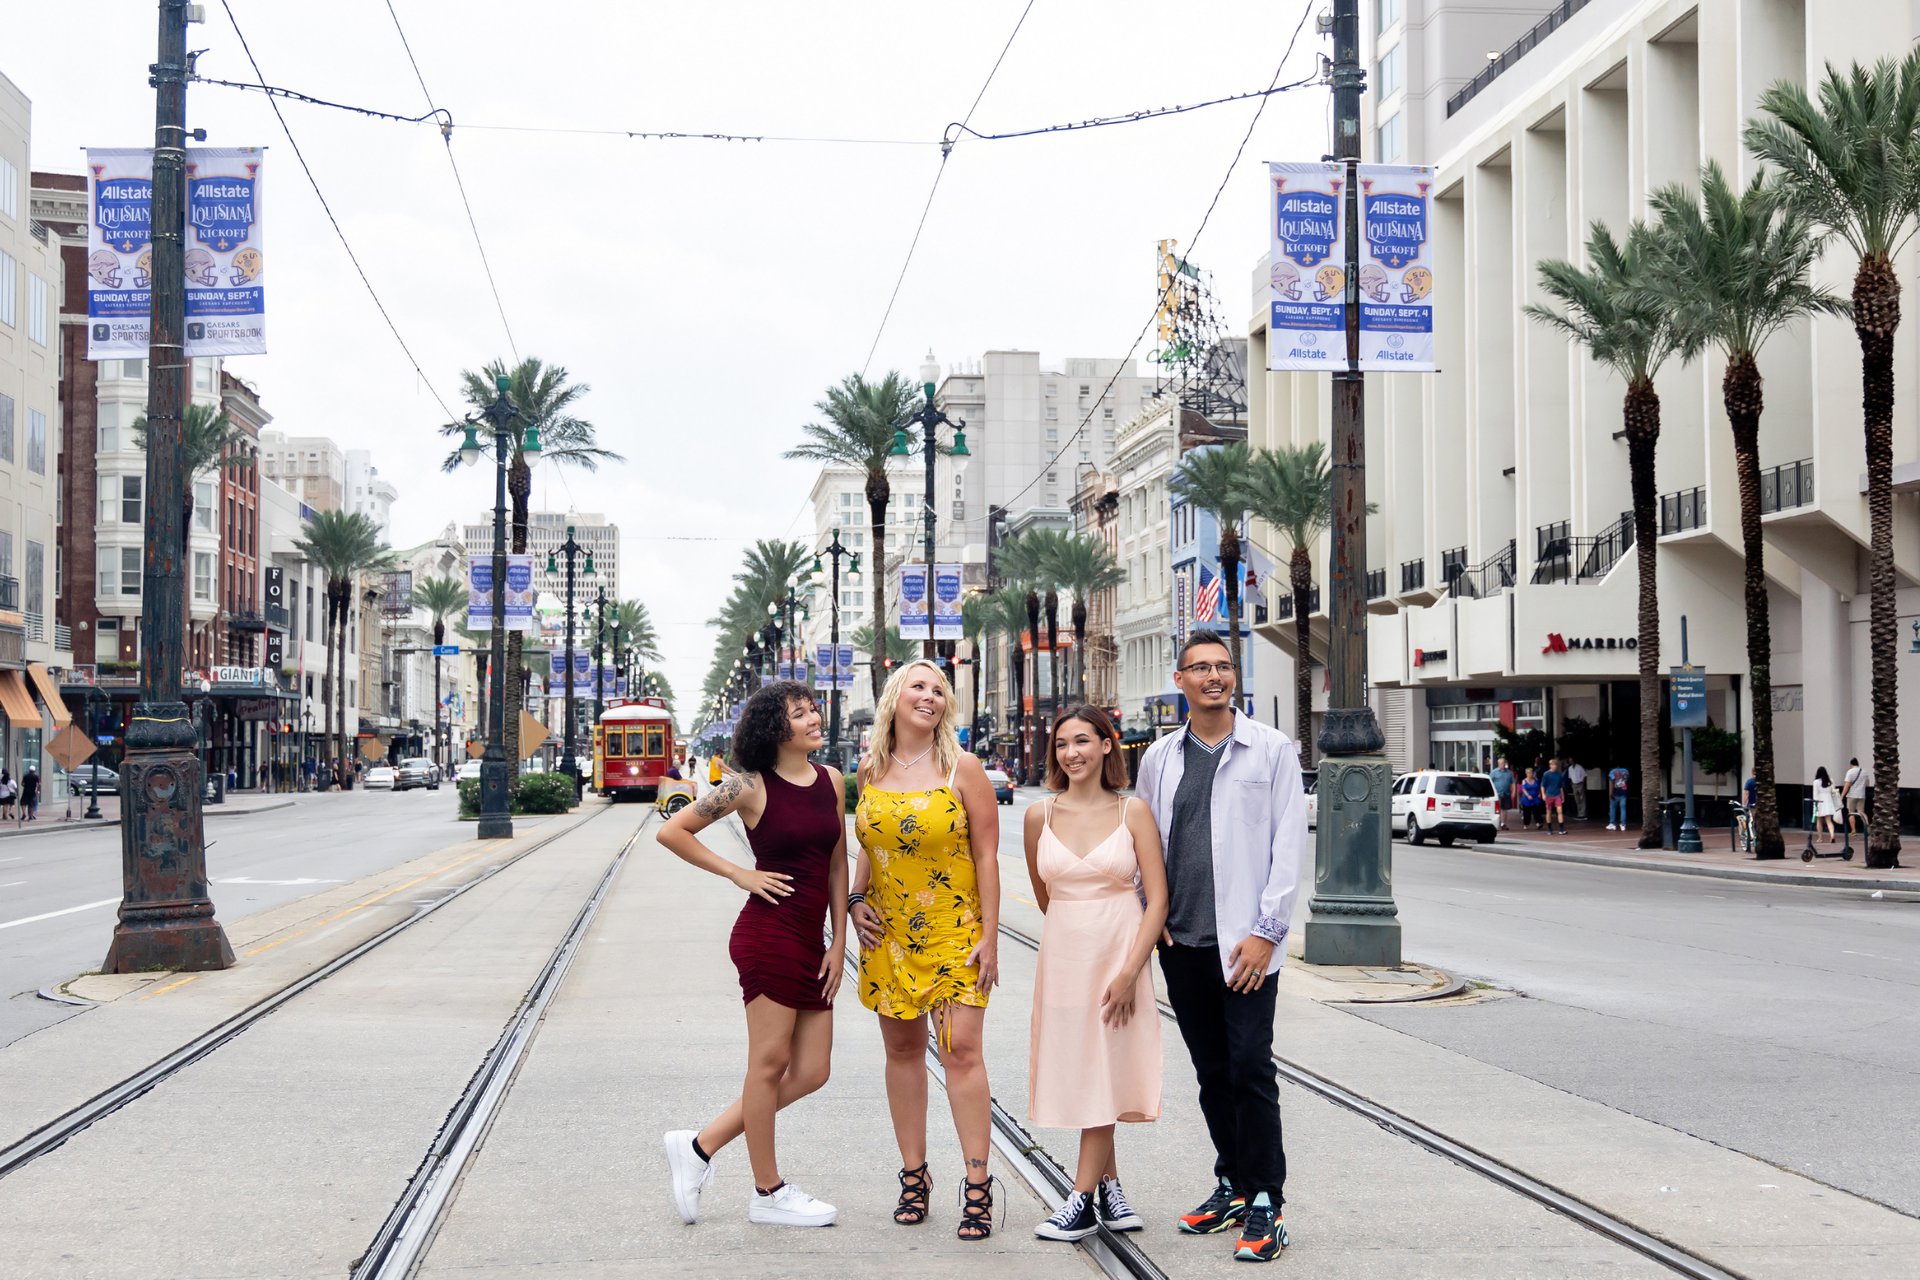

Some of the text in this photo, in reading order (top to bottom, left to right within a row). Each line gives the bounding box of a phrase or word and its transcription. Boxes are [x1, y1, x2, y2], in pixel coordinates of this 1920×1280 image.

[194, 184, 250, 198] Allstate
[1282, 200, 1333, 214] Allstate
[1369, 201, 1421, 216] Allstate
[191, 203, 253, 228] LOUISIANA
[105, 229, 152, 241] KICKOFF
[199, 228, 248, 239] KICKOFF
[1279, 218, 1336, 242] LOUISIANA
[1367, 220, 1424, 244] LOUISIANA
[1286, 243, 1329, 255] KICKOFF
[1373, 244, 1417, 256] KICKOFF
[237, 252, 258, 265] LSU
[1319, 270, 1340, 281] LSU
[1406, 271, 1428, 282] LSU
[93, 293, 131, 303] SUNDAY,
[187, 290, 259, 302] SUNDAY, SEPT. 4
[1275, 305, 1340, 316] SUNDAY, SEPT. 4
[1364, 306, 1429, 318] SUNDAY, SEPT. 4
[112, 323, 144, 331] CAESARS
[206, 321, 240, 329] CAESARS
[207, 328, 262, 339] SPORTSBOOK
[1288, 348, 1327, 360] Allstate
[1375, 350, 1414, 362] Allstate
[1568, 637, 1638, 649] MARRIO
